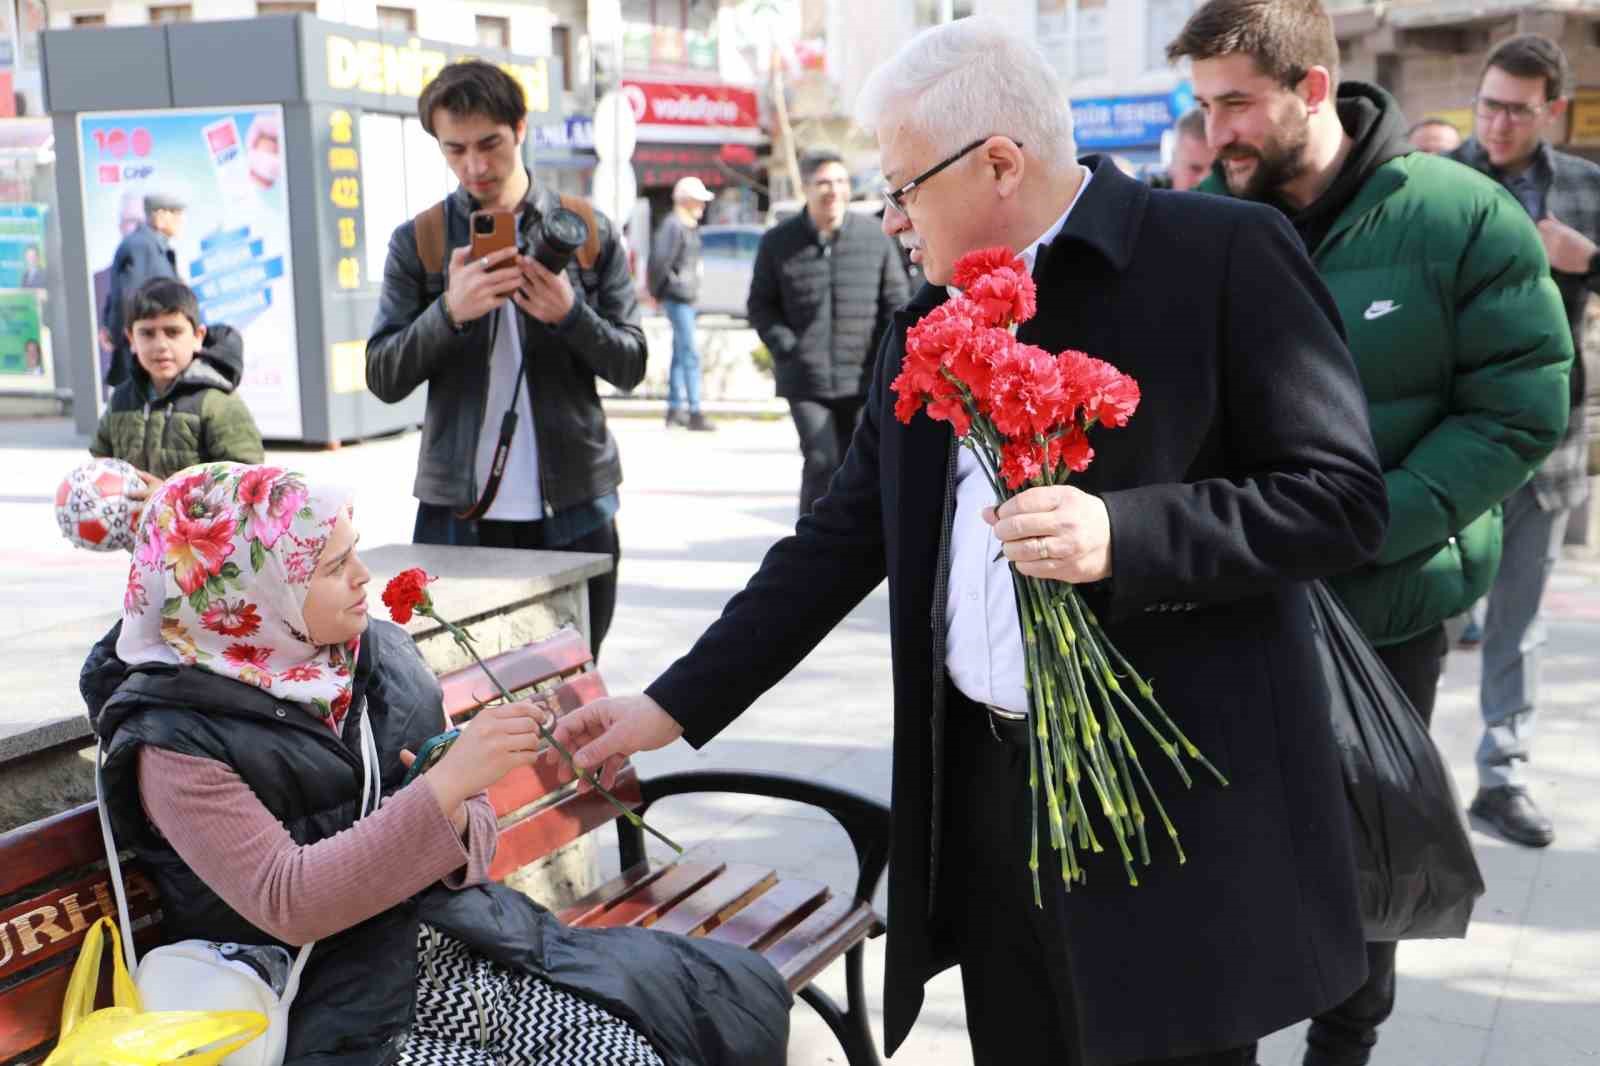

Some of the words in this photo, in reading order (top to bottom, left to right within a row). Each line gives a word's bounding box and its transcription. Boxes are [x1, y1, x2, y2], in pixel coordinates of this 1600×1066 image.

[653, 94, 739, 121] vodafone
[92, 127, 153, 159] 100
[123, 165, 154, 180] CHP
